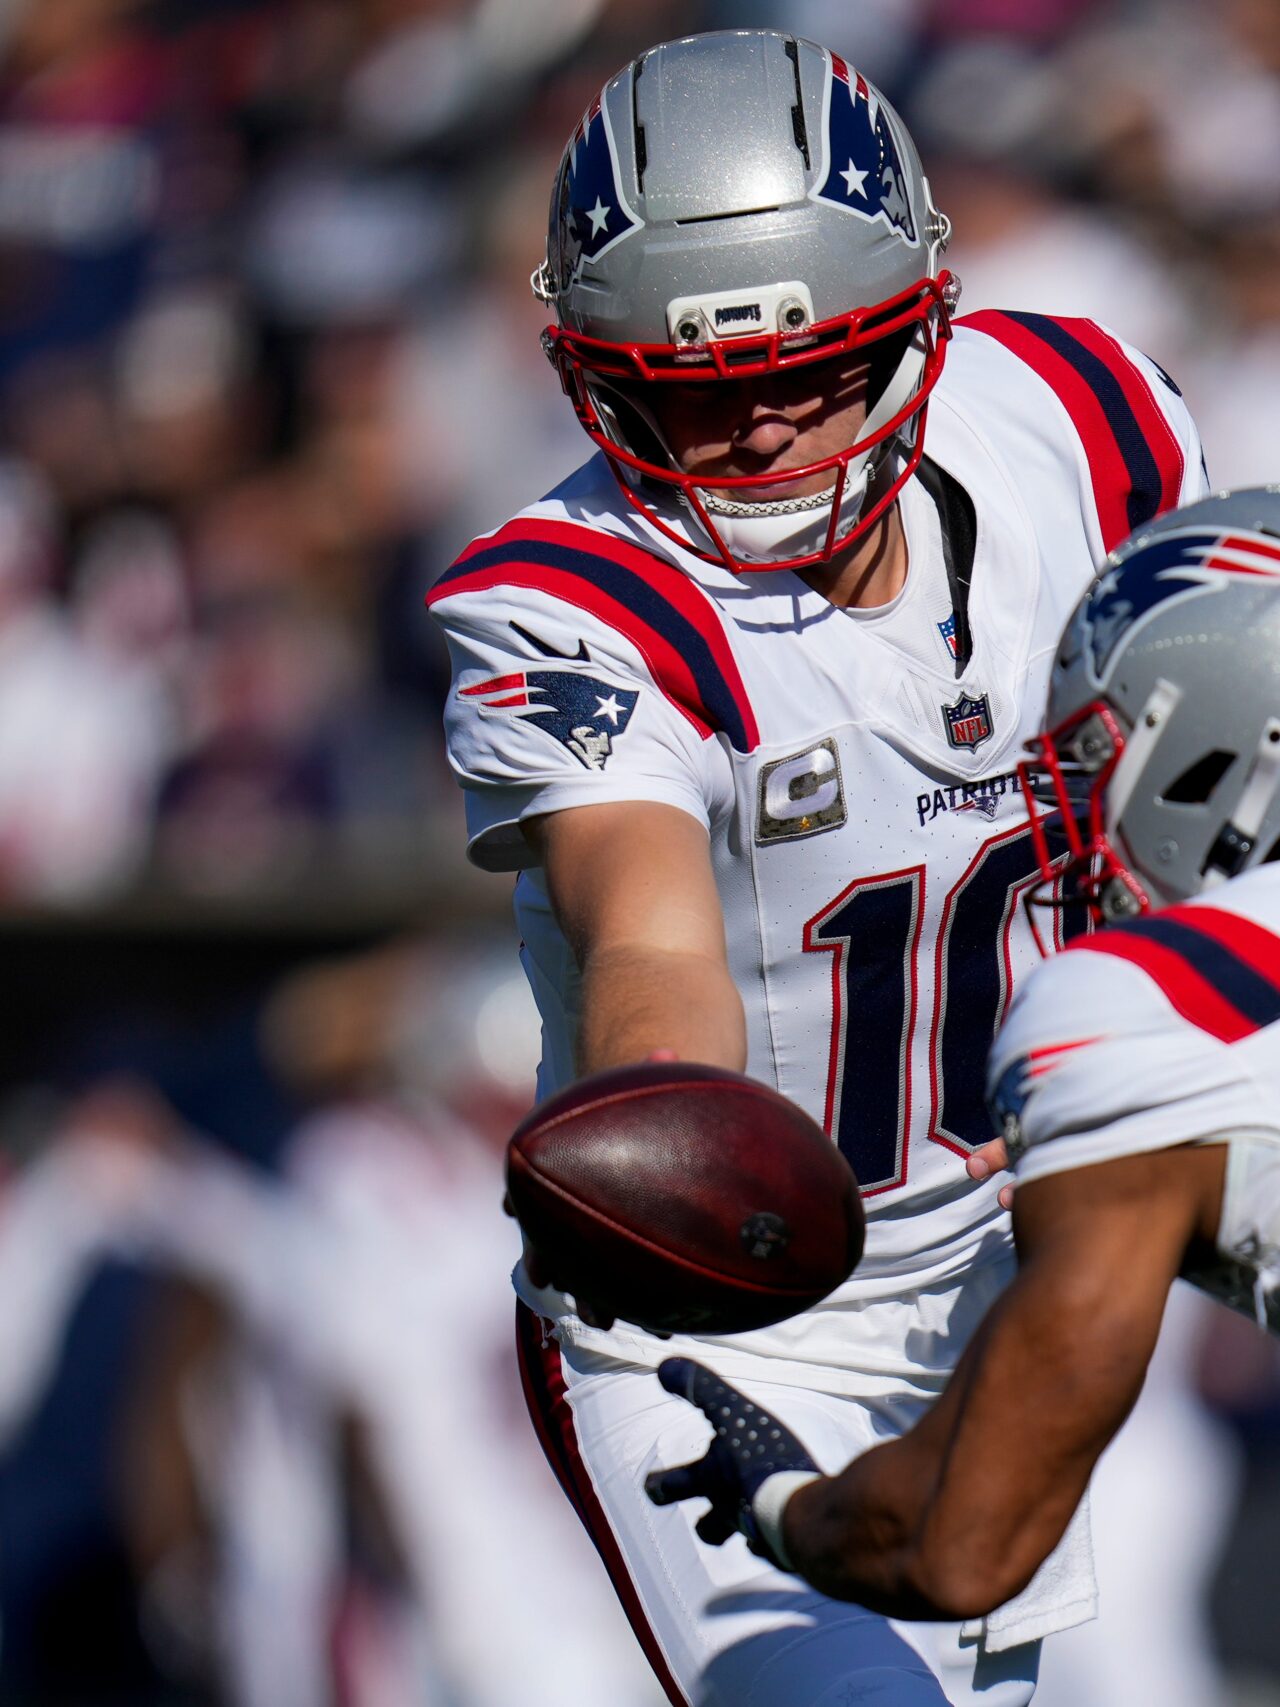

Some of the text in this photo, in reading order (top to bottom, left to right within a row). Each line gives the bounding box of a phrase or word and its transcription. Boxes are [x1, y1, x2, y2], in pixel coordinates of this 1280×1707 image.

[952, 717, 988, 742] NFL
[765, 747, 839, 821] C
[802, 808, 1098, 1198] 10
